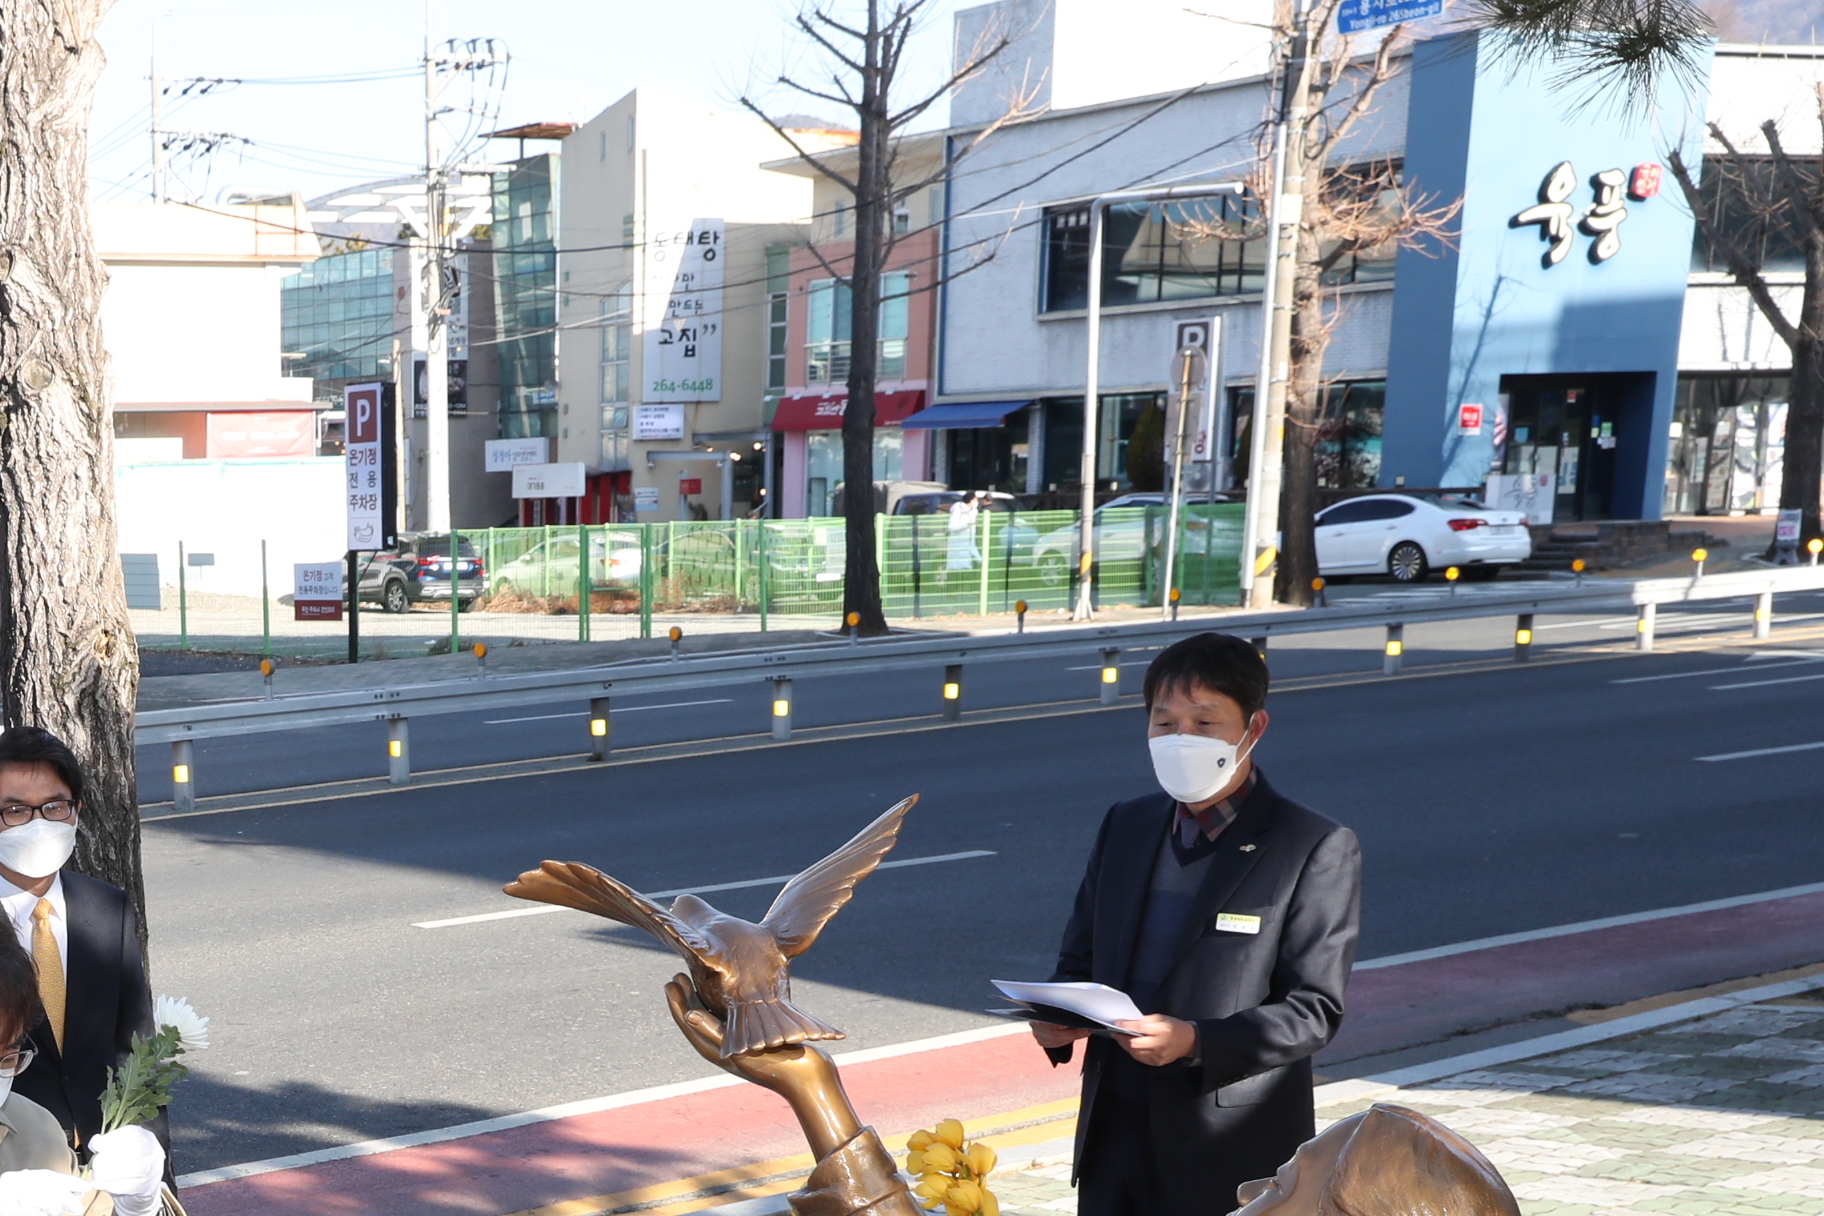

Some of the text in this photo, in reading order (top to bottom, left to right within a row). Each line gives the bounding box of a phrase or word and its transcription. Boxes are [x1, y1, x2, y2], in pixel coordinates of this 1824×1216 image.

[1510, 160, 1627, 268] 육풍
[652, 378, 714, 393] 264-6448
[356, 398, 371, 437] P
[349, 448, 377, 466] 온기정
[349, 494, 377, 512] 주차장
